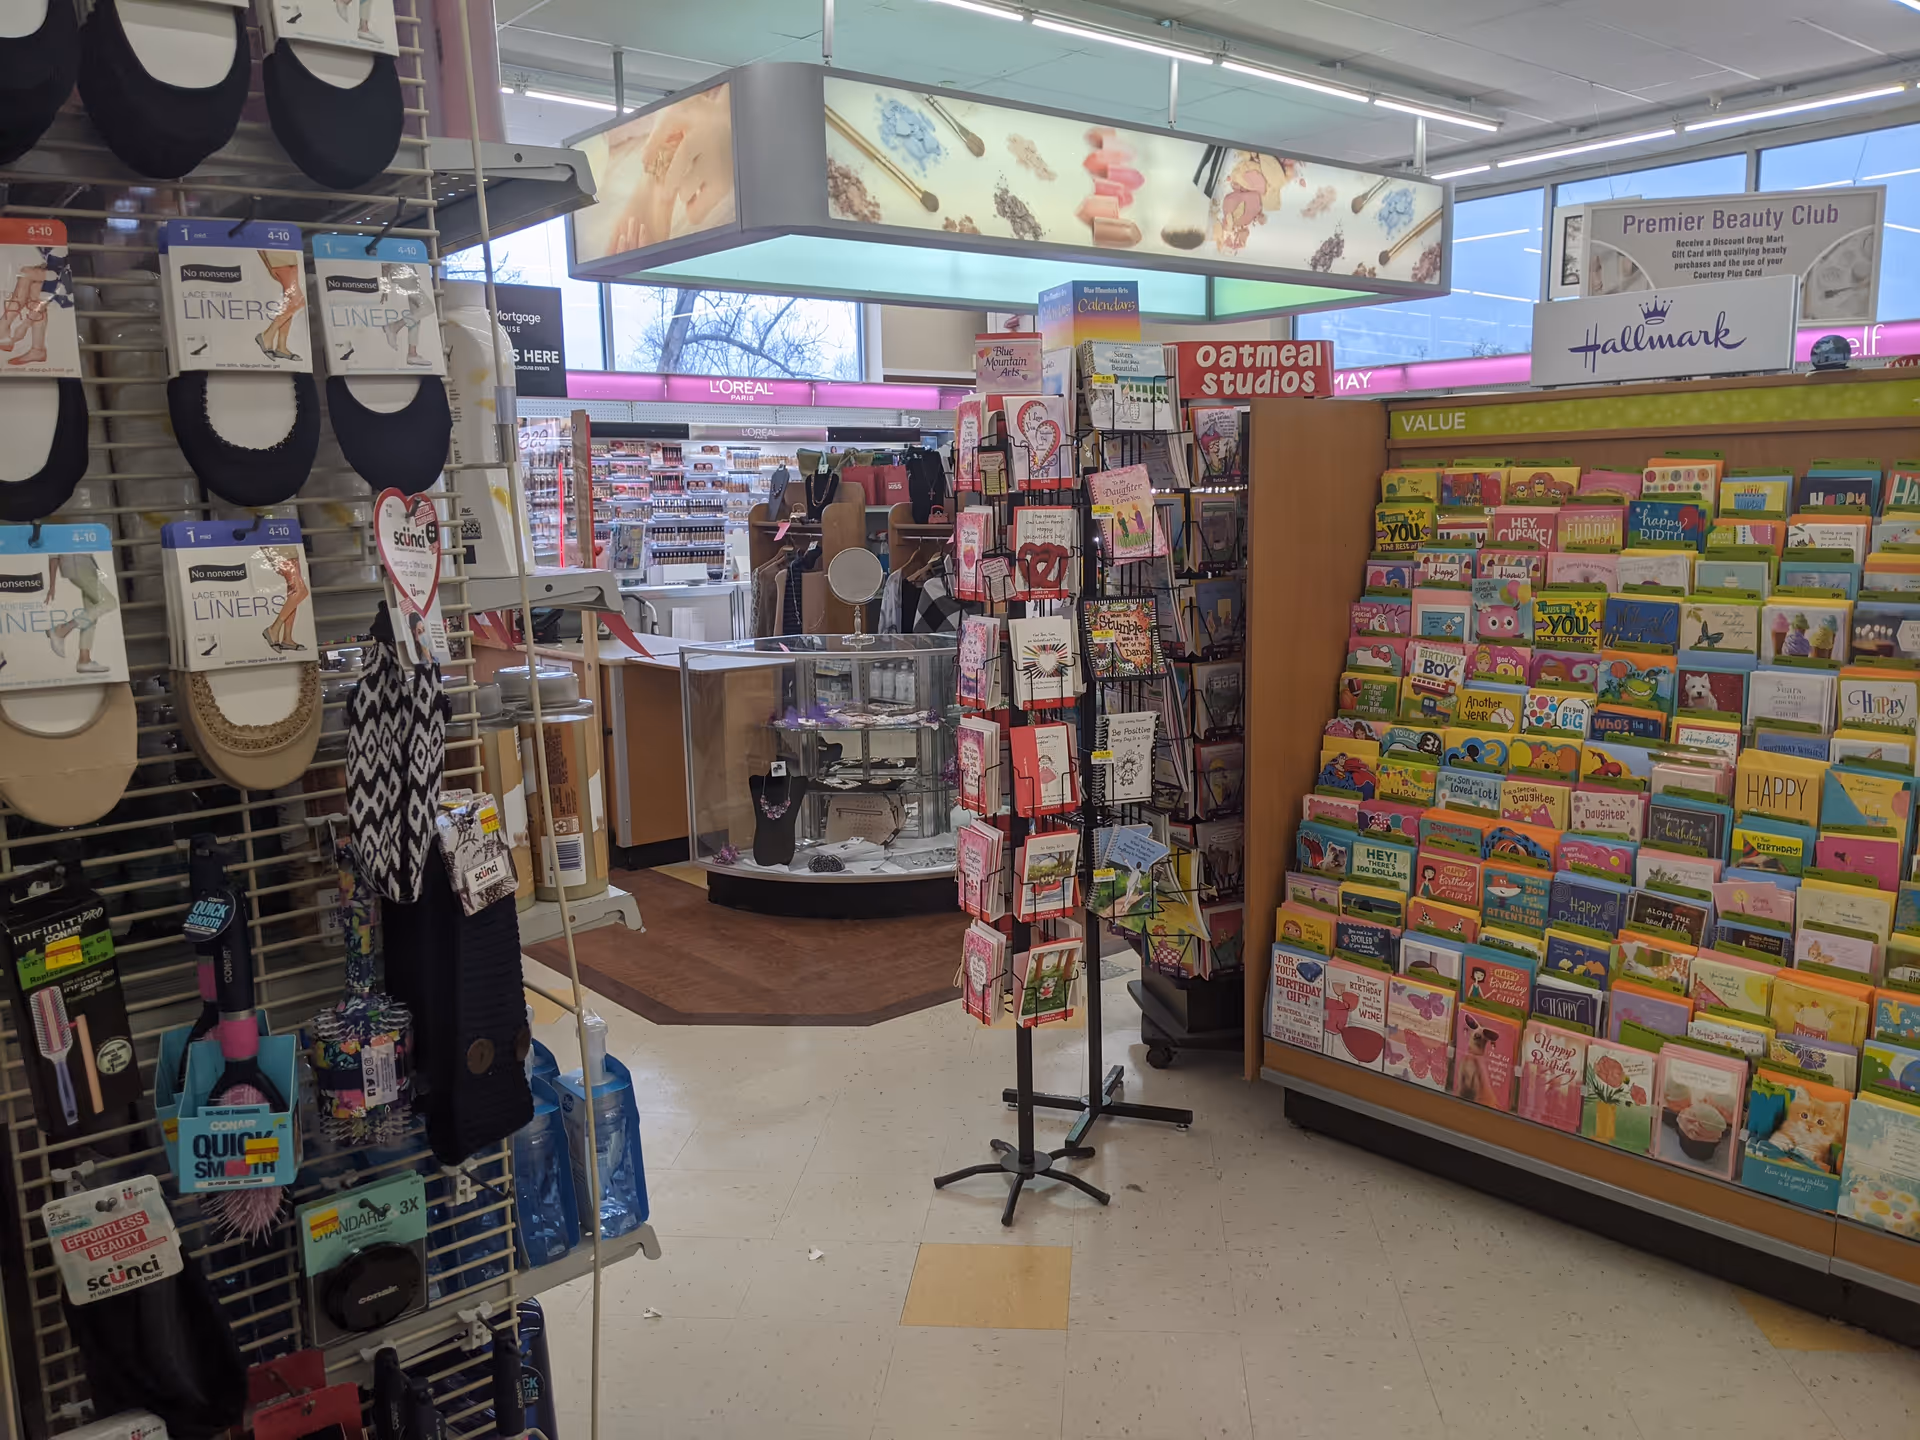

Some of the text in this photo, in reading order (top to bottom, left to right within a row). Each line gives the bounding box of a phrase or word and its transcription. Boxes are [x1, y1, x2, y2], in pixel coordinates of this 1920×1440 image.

[1623, 203, 1839, 235] Premier Beauty Club
[27, 225, 53, 237] 4-10
[1676, 239, 1705, 248] Receive
[1713, 236, 1745, 246] Discount
[1747, 235, 1764, 246] Drug
[1766, 234, 1784, 243] Mart
[1671, 245, 1787, 259] Gift Card with qualifying beauty
[1674, 257, 1783, 271] purchases and the use of your
[183, 268, 240, 280] No nonsense
[1693, 267, 1763, 280] Courtesy Plus Card
[328, 279, 377, 290] No nonsense
[182, 291, 208, 299] LACE
[183, 299, 283, 321] LINERS
[1077, 297, 1136, 313] Calendars
[1568, 310, 1747, 373] Hallmark
[523, 349, 560, 364] HERE
[992, 346, 1014, 357] Blue
[1113, 351, 1134, 359] Sisters
[1195, 341, 1322, 368] oatmeal
[983, 356, 1028, 372] Mountain
[1111, 363, 1140, 373] Beautiful
[709, 379, 774, 396] L'ORÉAL
[1200, 369, 1316, 396] studios
[730, 394, 754, 402] PARIS
[1401, 412, 1466, 432] VALUE
[1116, 497, 1128, 506] Love
[1129, 495, 1141, 503] You
[1511, 517, 1538, 529] HEY,
[1638, 508, 1689, 534] happy
[72, 530, 97, 543] 4-10
[187, 529, 196, 543] 1
[268, 525, 290, 537] 4-10
[393, 526, 426, 549] scünci
[1386, 522, 1424, 543] YOU.
[1496, 528, 1553, 549] CUPCAKE!
[192, 568, 245, 581] No nonsense
[1432, 563, 1459, 578] Happy
[191, 590, 240, 600] LACE TRIM
[193, 595, 286, 621] LINERS
[1543, 604, 1561, 614] JUST
[1099, 614, 1144, 636] Stumble
[1548, 615, 1593, 636] YOU.
[1125, 648, 1151, 657] Dance
[1419, 648, 1464, 666] BIRTHDAY
[1496, 656, 1517, 666] You're
[1422, 660, 1456, 679] BOY
[1465, 695, 1503, 709] Another
[1111, 726, 1151, 737] Be Positive
[1393, 727, 1420, 743] YOU'RE
[1425, 735, 1440, 752] 3!
[1684, 734, 1731, 748] Happy Birthday
[1484, 743, 1501, 767] 2
[1444, 775, 1453, 783] For
[1457, 775, 1471, 786] Son
[1746, 773, 1808, 810] HAPPY
[1366, 848, 1398, 863] HEY!
[1756, 842, 1801, 856] BIRTHDAY!
[474, 860, 499, 882] scünci
[1356, 864, 1408, 880] 100 DOLLARS
[1368, 860, 1397, 871] THERE'S
[1439, 874, 1475, 888] Birthday
[192, 899, 230, 920] QUICK
[1569, 896, 1602, 914] Happy
[185, 913, 223, 930] SMOOTH
[1486, 906, 1544, 927] ATTENTION
[1644, 917, 1664, 930] road
[1647, 907, 1691, 924] ALONG THE
[44, 924, 82, 945] CONAIR
[1350, 934, 1373, 945] SPOILED
[224, 948, 233, 985] CONAIR
[1277, 953, 1295, 967] FOR
[1274, 963, 1298, 979] YOUR
[1495, 969, 1518, 981] HAPPY
[1275, 975, 1322, 999] BIRTHDAY
[1349, 981, 1382, 997] BIRTHDAY
[1489, 976, 1528, 994] Birthday
[1286, 989, 1312, 1008] GIFT,
[1358, 1007, 1383, 1023] WINE!
[1534, 1032, 1577, 1059] Happy
[1531, 1048, 1578, 1077] Birthday
[209, 1119, 257, 1132] CONAIR
[399, 1196, 420, 1216] 3X
[64, 1213, 146, 1251] EFFORTLESS
[91, 1231, 141, 1259] BEAUTY
[86, 1253, 162, 1292] scünci
[97, 1287, 112, 1298] HAIR
[111, 1278, 144, 1294] ACCESSORY
